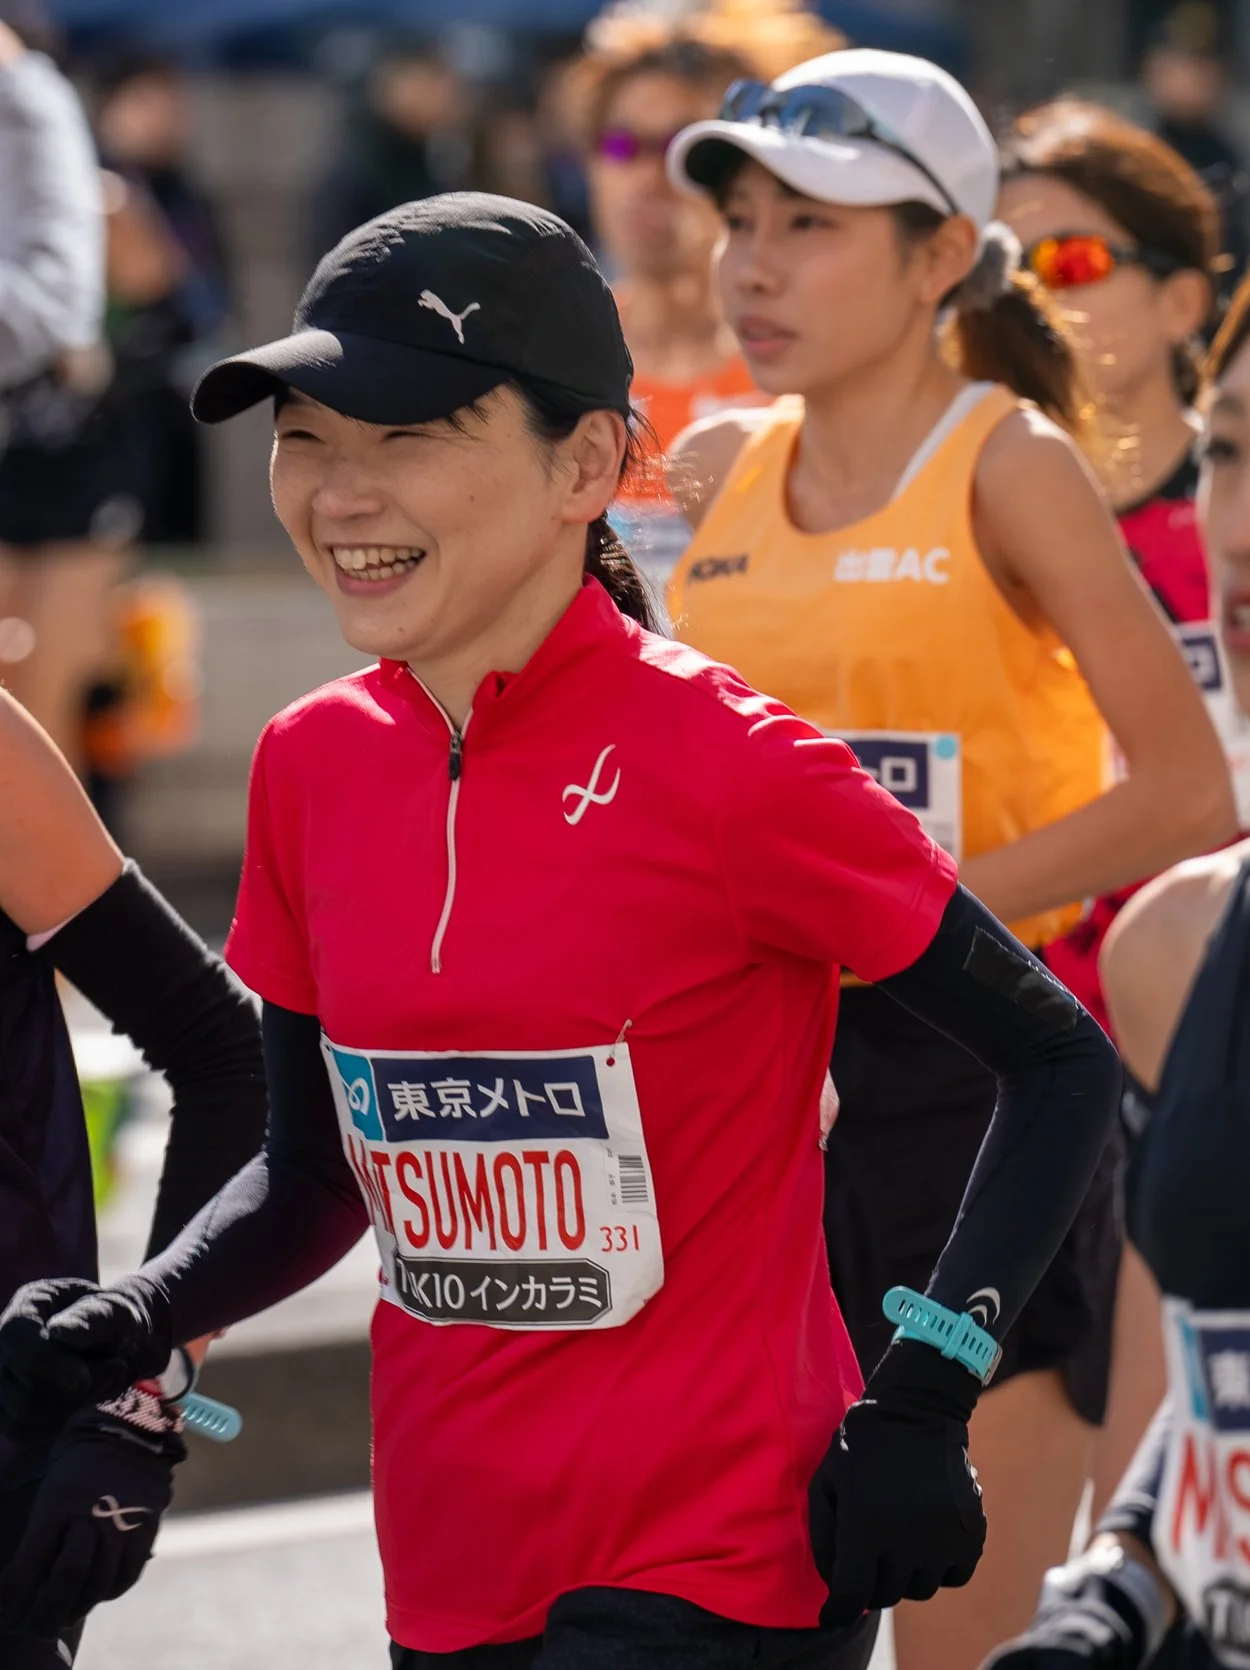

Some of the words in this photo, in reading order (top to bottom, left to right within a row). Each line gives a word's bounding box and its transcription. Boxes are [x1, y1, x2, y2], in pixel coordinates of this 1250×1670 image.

[388, 1077, 586, 1120] 東京メトロ
[599, 1225, 639, 1251] 331
[470, 1275, 602, 1311] インカラミ
